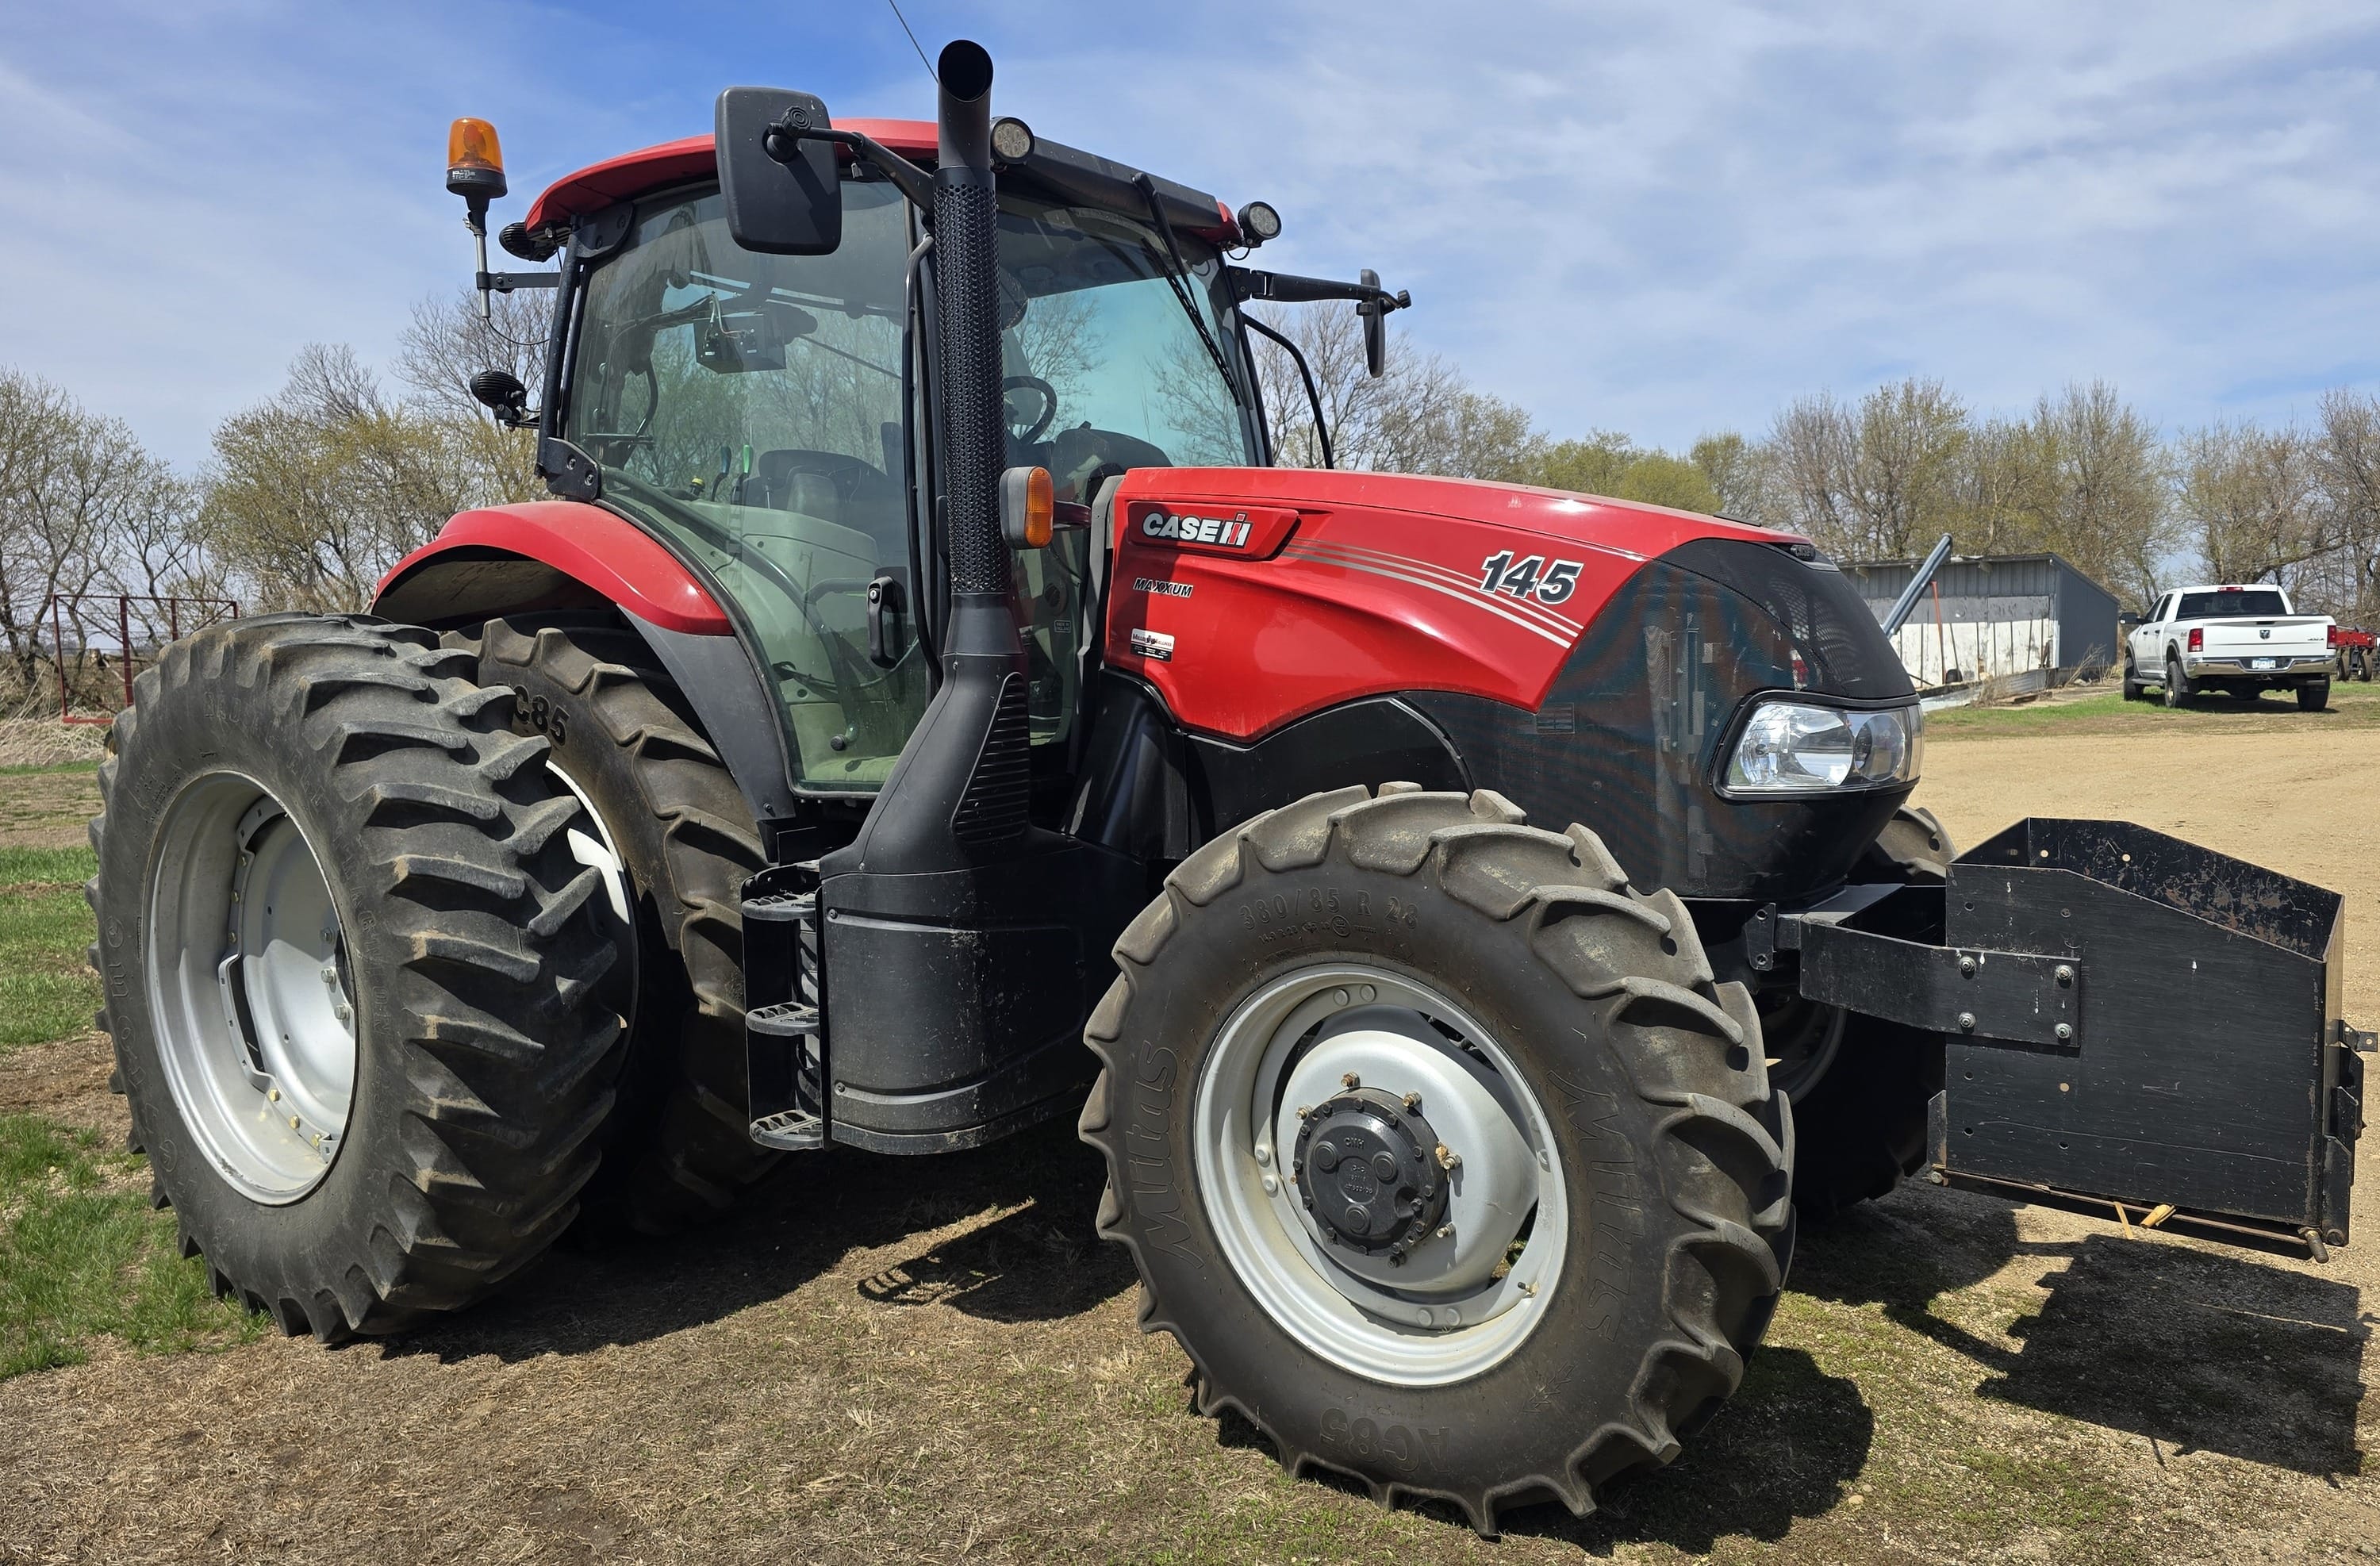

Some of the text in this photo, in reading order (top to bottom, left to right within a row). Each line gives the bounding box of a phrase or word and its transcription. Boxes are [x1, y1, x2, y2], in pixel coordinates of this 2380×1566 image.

[1133, 578, 1193, 597] MAXXUM
[1479, 550, 1584, 605] 145
[1239, 887, 1418, 931] 380/85 R 28
[1320, 1407, 1455, 1473] AC85
